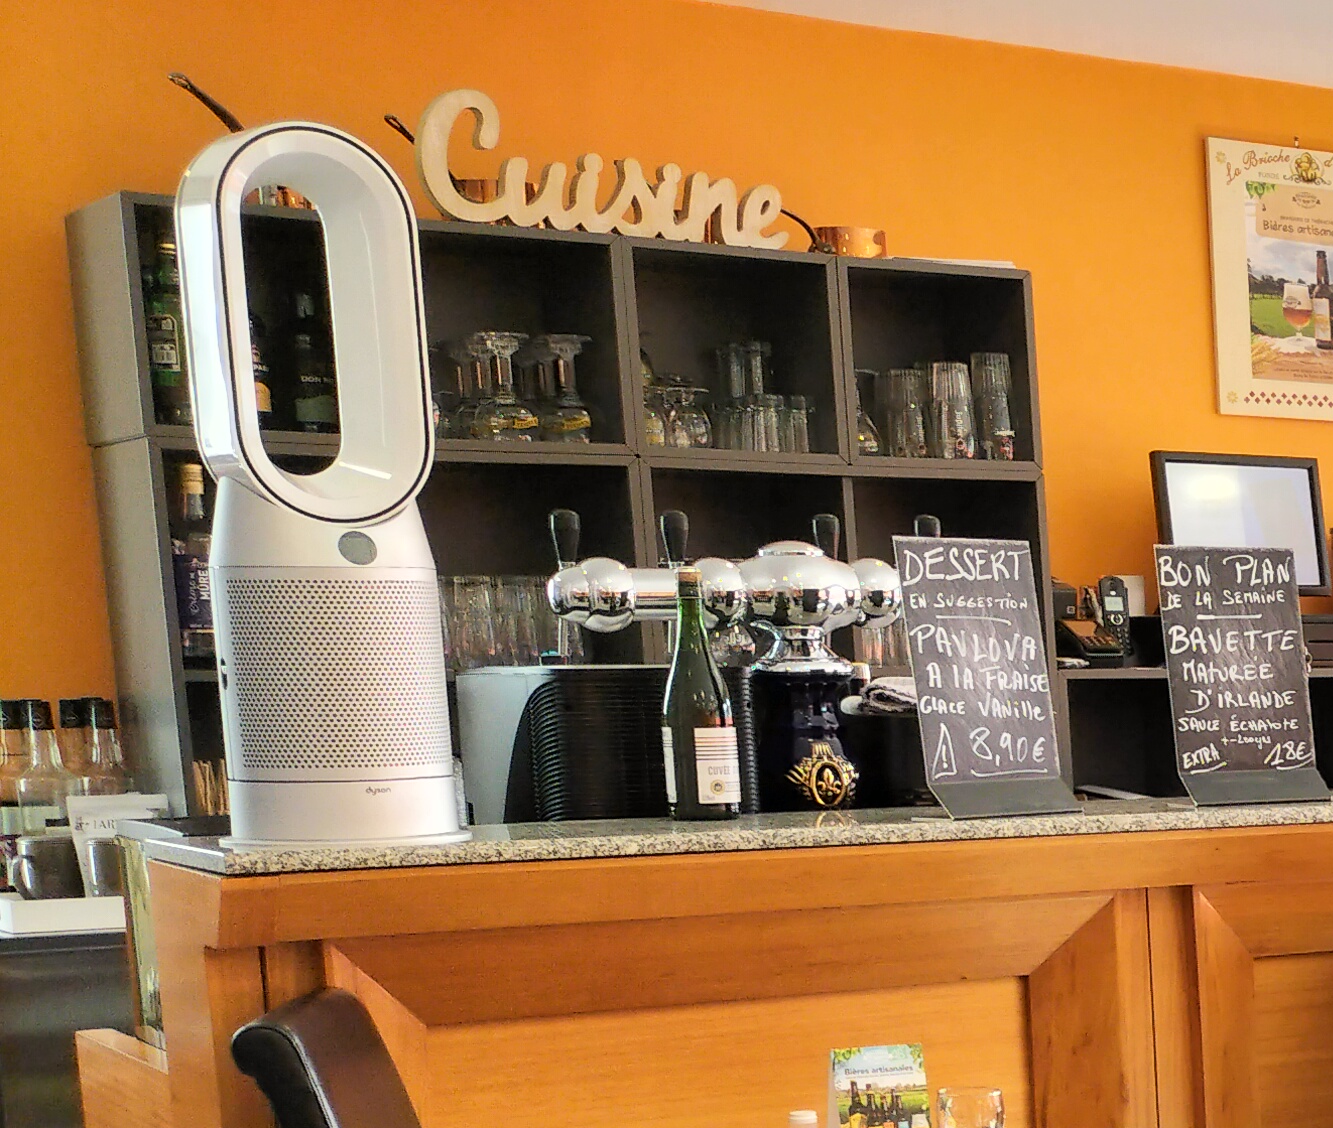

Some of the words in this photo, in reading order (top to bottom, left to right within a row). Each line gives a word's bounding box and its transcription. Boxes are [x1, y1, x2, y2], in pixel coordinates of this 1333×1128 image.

[415, 88, 789, 250] Cuisine
[1263, 220, 1294, 233] Bières
[902, 547, 1030, 586] DESSERT
[1158, 555, 1212, 587] BON
[1222, 554, 1292, 586] PLAN
[909, 593, 928, 609] EN
[934, 592, 1028, 610] SUGGESTION
[1162, 591, 1182, 611] DE
[1195, 591, 1213, 609] LA
[1222, 587, 1286, 605] SEMAINE
[909, 624, 1036, 663] PAVLOVA
[1168, 625, 1298, 655] BAVETTE
[926, 662, 942, 689] A
[979, 662, 1050, 693] FRAISE
[919, 695, 966, 715] GLACE
[1178, 718, 1220, 732] SAUCE
[969, 726, 1046, 767] 8,90€
[1182, 743, 1221, 769] EXTRA
[1264, 741, 1312, 766] 18€
[366, 786, 391, 796] dyson
[844, 1066, 870, 1076] Bières
[872, 1064, 913, 1074] artisanales
